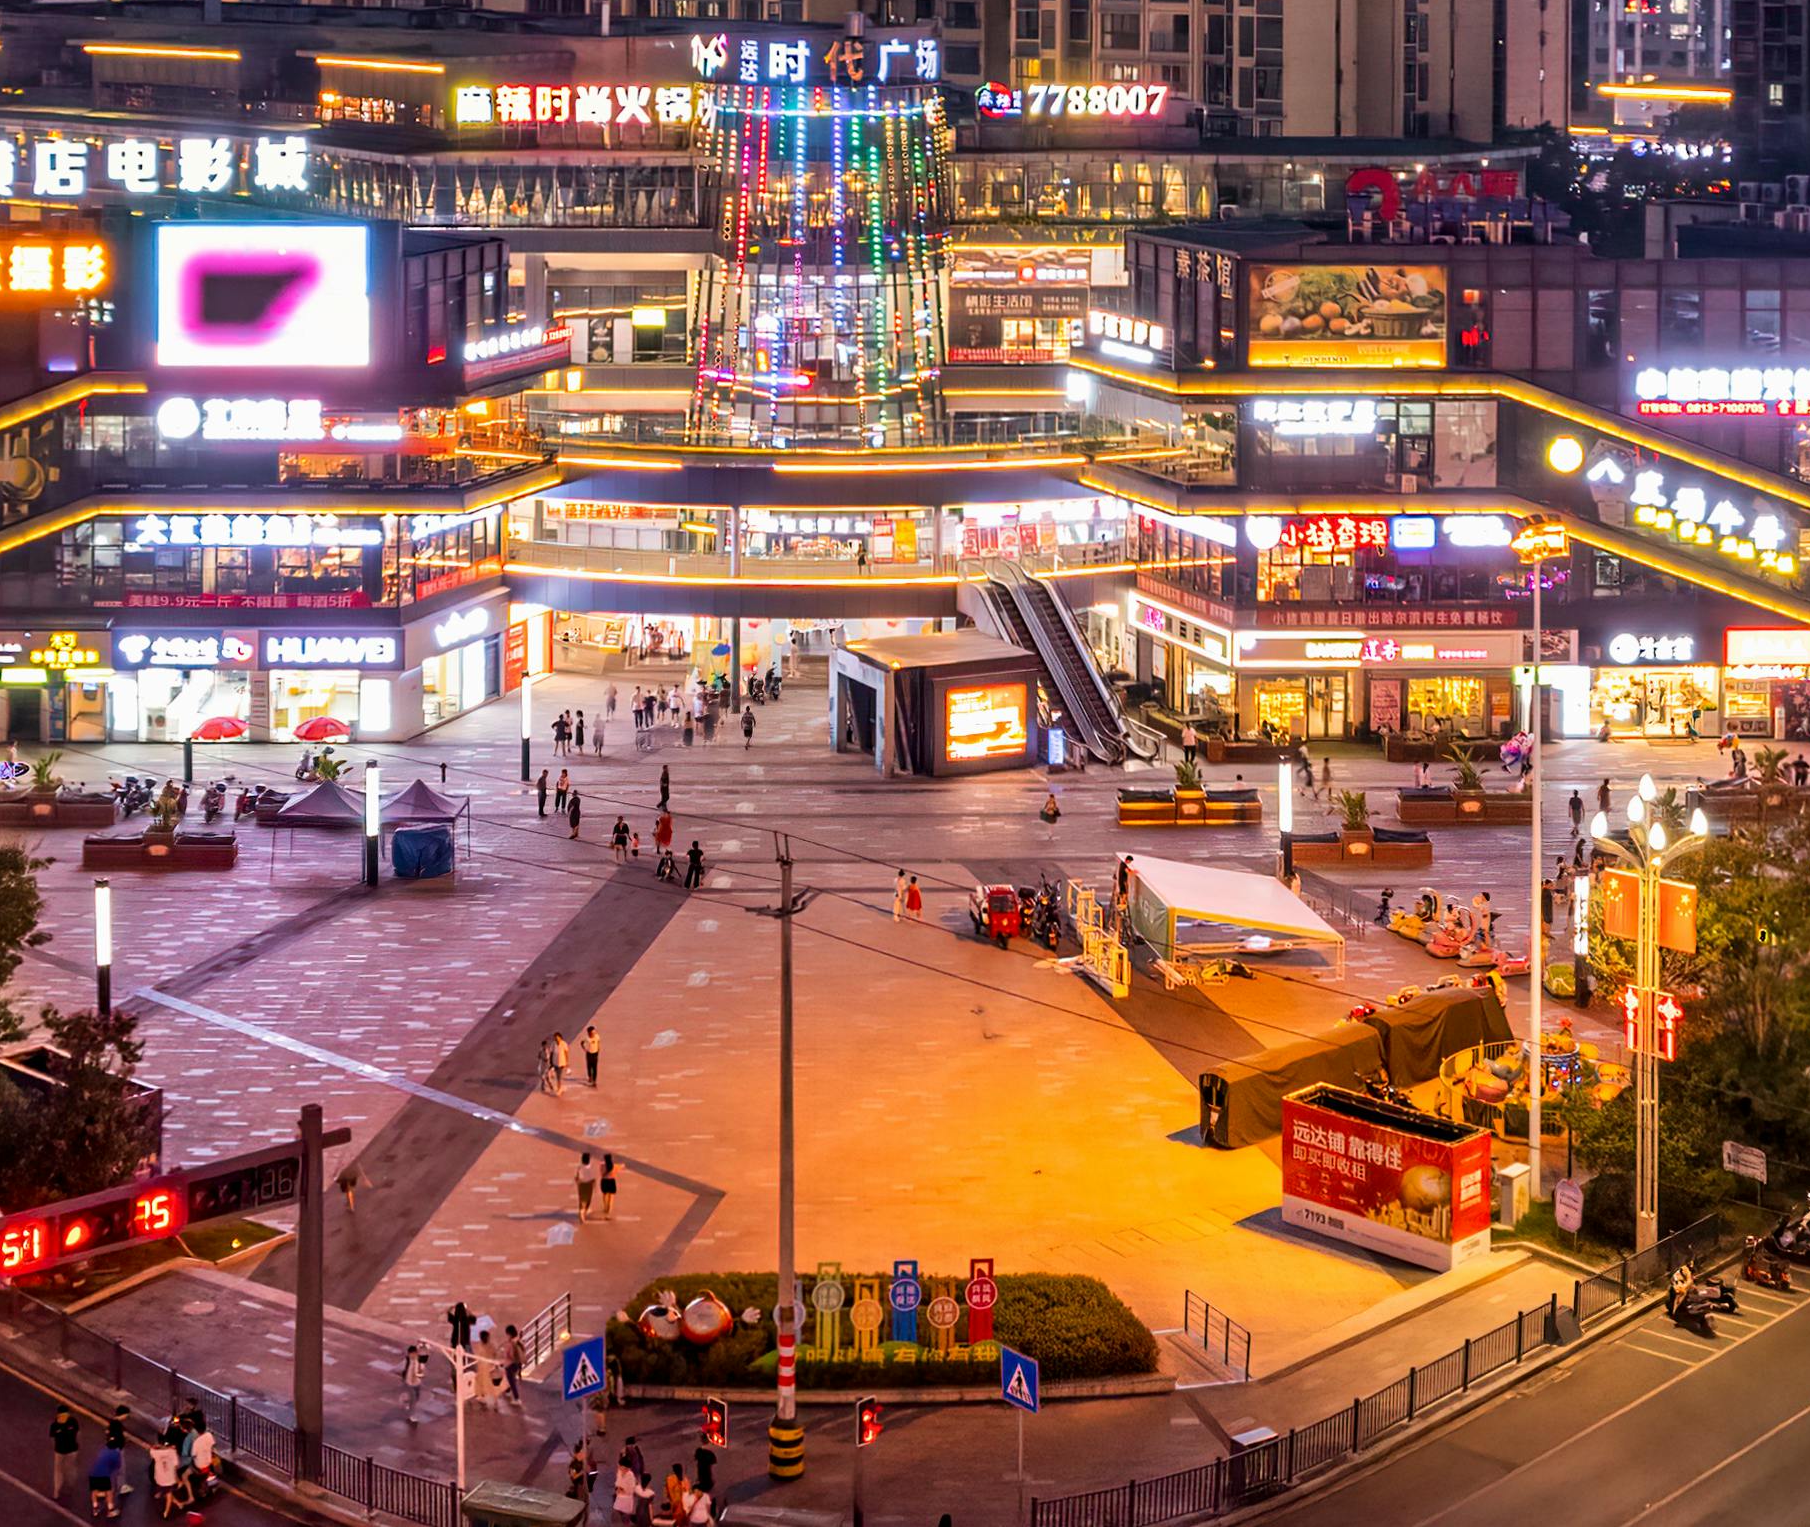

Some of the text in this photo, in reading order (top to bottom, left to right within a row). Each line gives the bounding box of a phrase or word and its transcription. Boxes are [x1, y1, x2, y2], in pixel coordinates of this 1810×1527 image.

[768, 37, 940, 83] 时代广场
[1028, 84, 1168, 115] 7788007
[266, 636, 396, 663] HUAWEI
[1292, 1119, 1403, 1171] 远达铺 靠得住
[1292, 1143, 1367, 1182] 即买即收租
